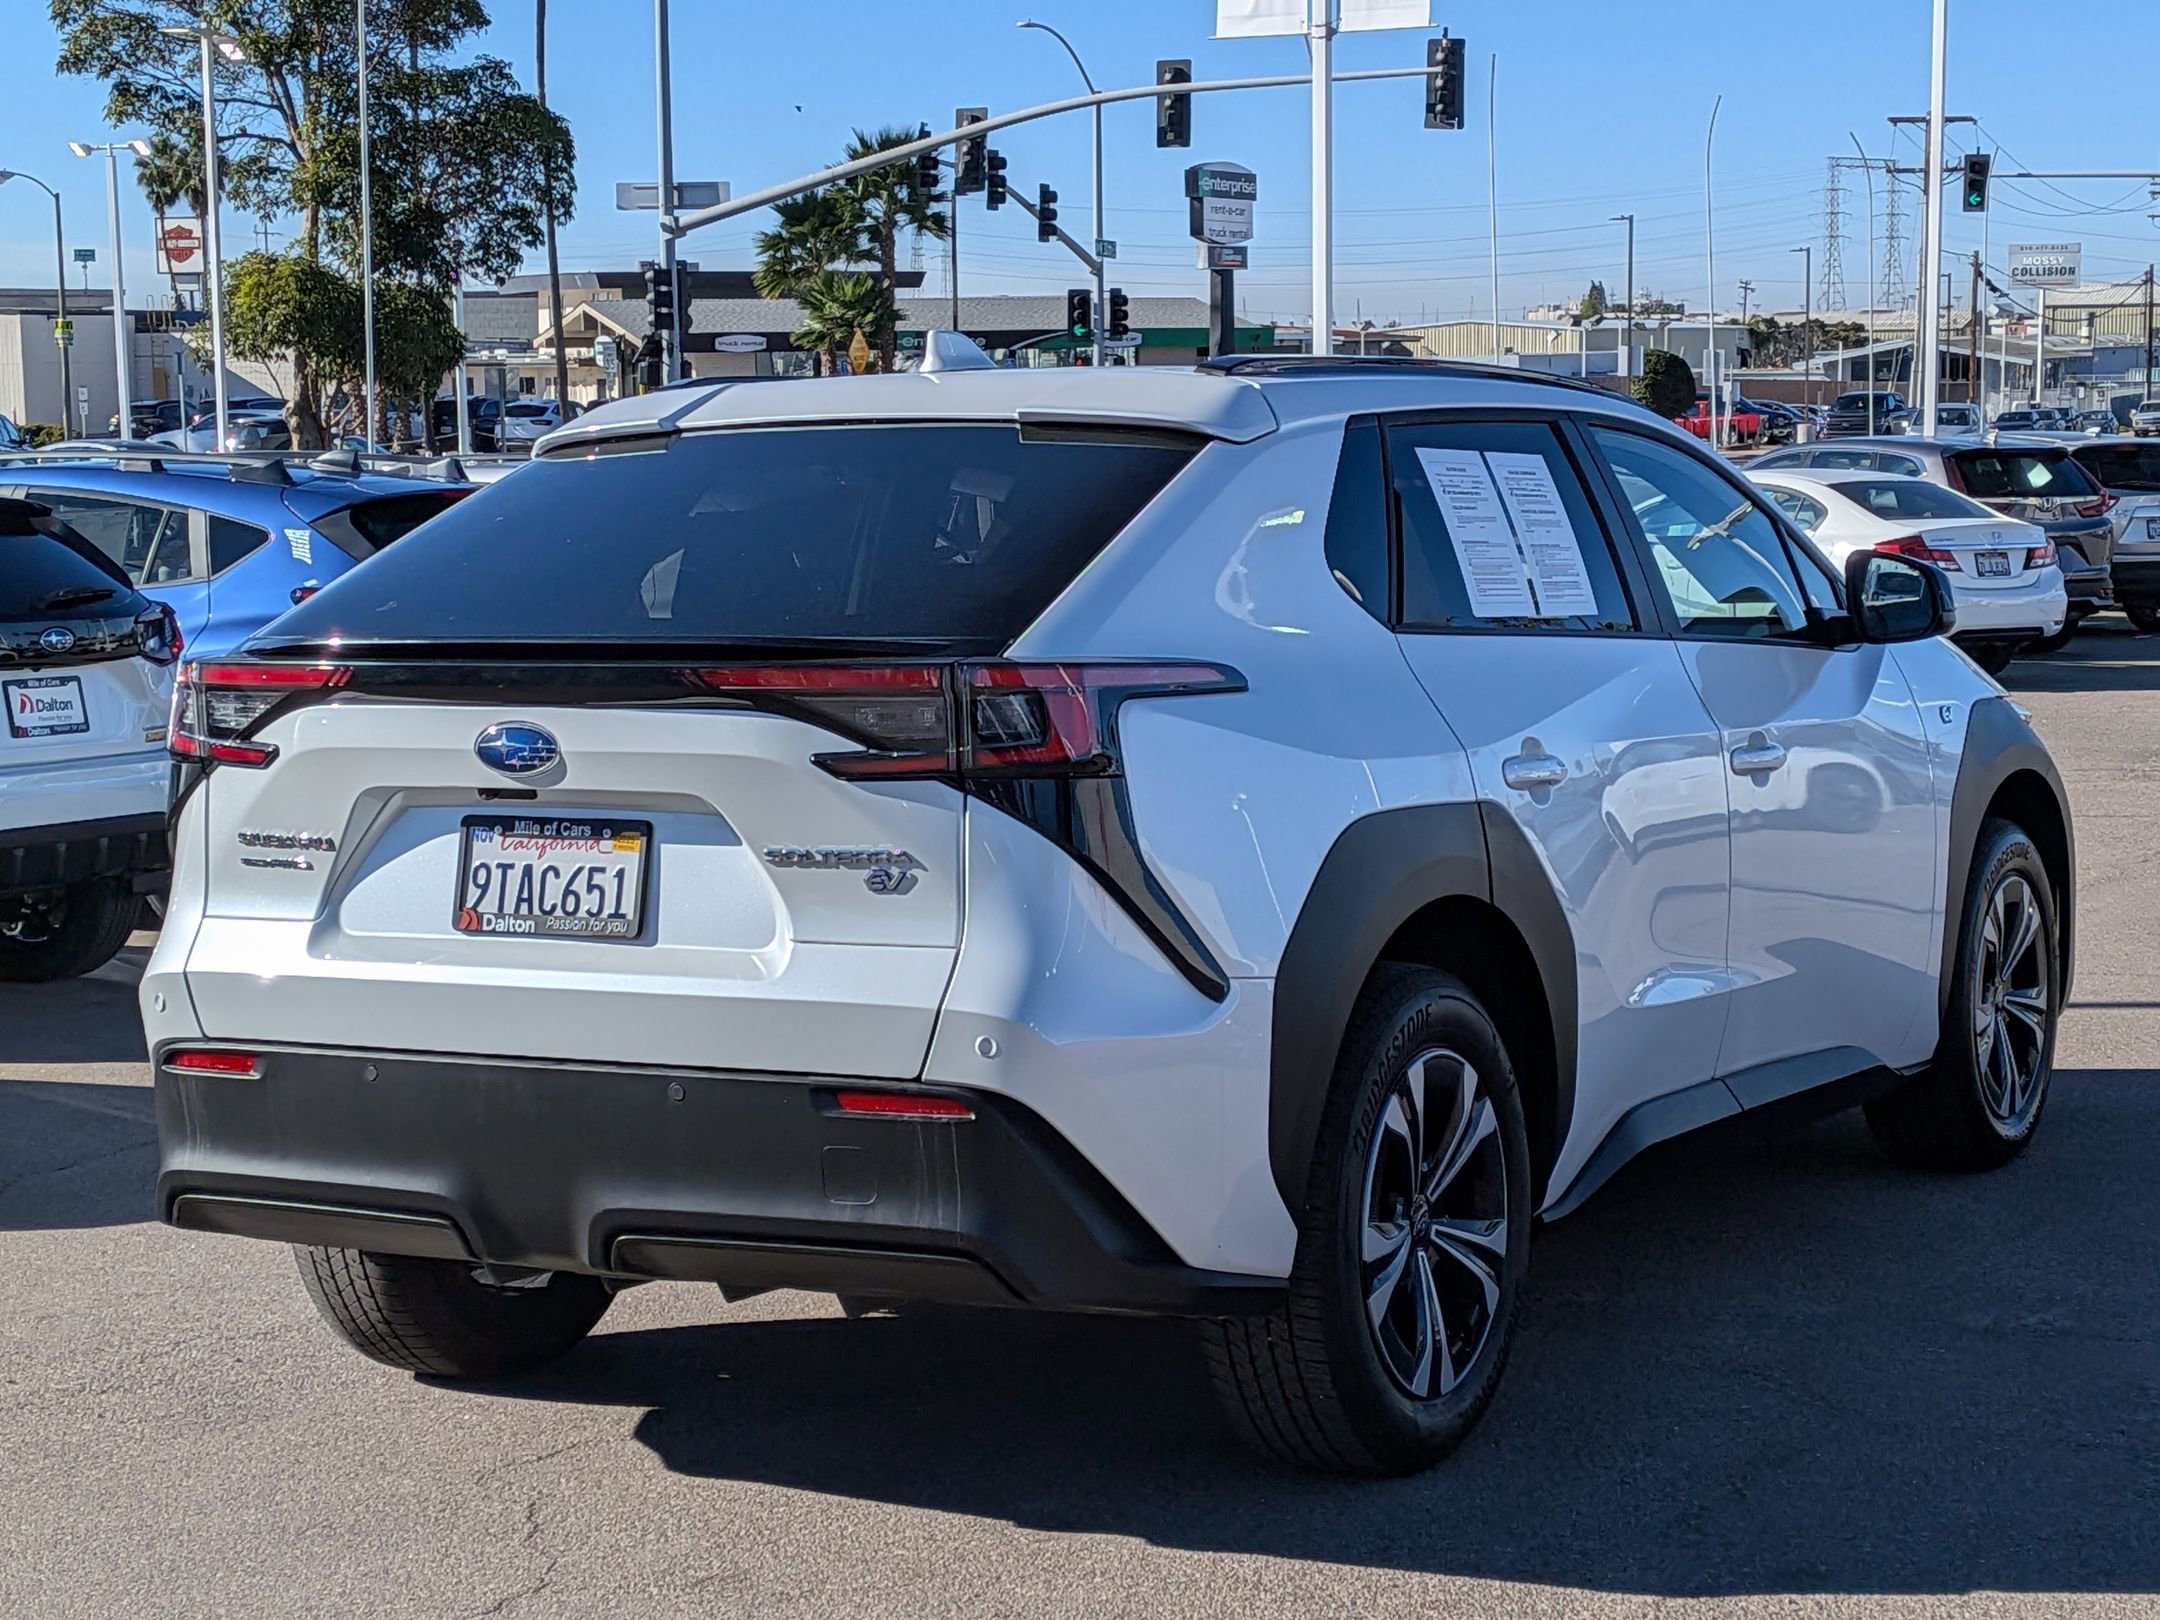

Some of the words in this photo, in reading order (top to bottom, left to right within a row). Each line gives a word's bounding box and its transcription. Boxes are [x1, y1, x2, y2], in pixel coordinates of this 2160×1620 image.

[1201, 176, 1256, 196] enterprise
[1210, 204, 1246, 217] rent-a-car
[1208, 226, 1227, 239] truck
[2022, 255, 2065, 266] MOSSY
[2011, 266, 2076, 277] COLLISION
[35, 696, 74, 713] Dalton
[472, 827, 495, 843] NOV
[514, 820, 540, 835] Mile
[543, 821, 558, 835] of
[560, 822, 592, 837] Cars
[867, 867, 910, 892] EV
[471, 861, 627, 919] 9TAC651
[482, 915, 536, 934] Dalton
[546, 917, 586, 932] Passion
[587, 918, 606, 932] for
[606, 921, 629, 934] you
